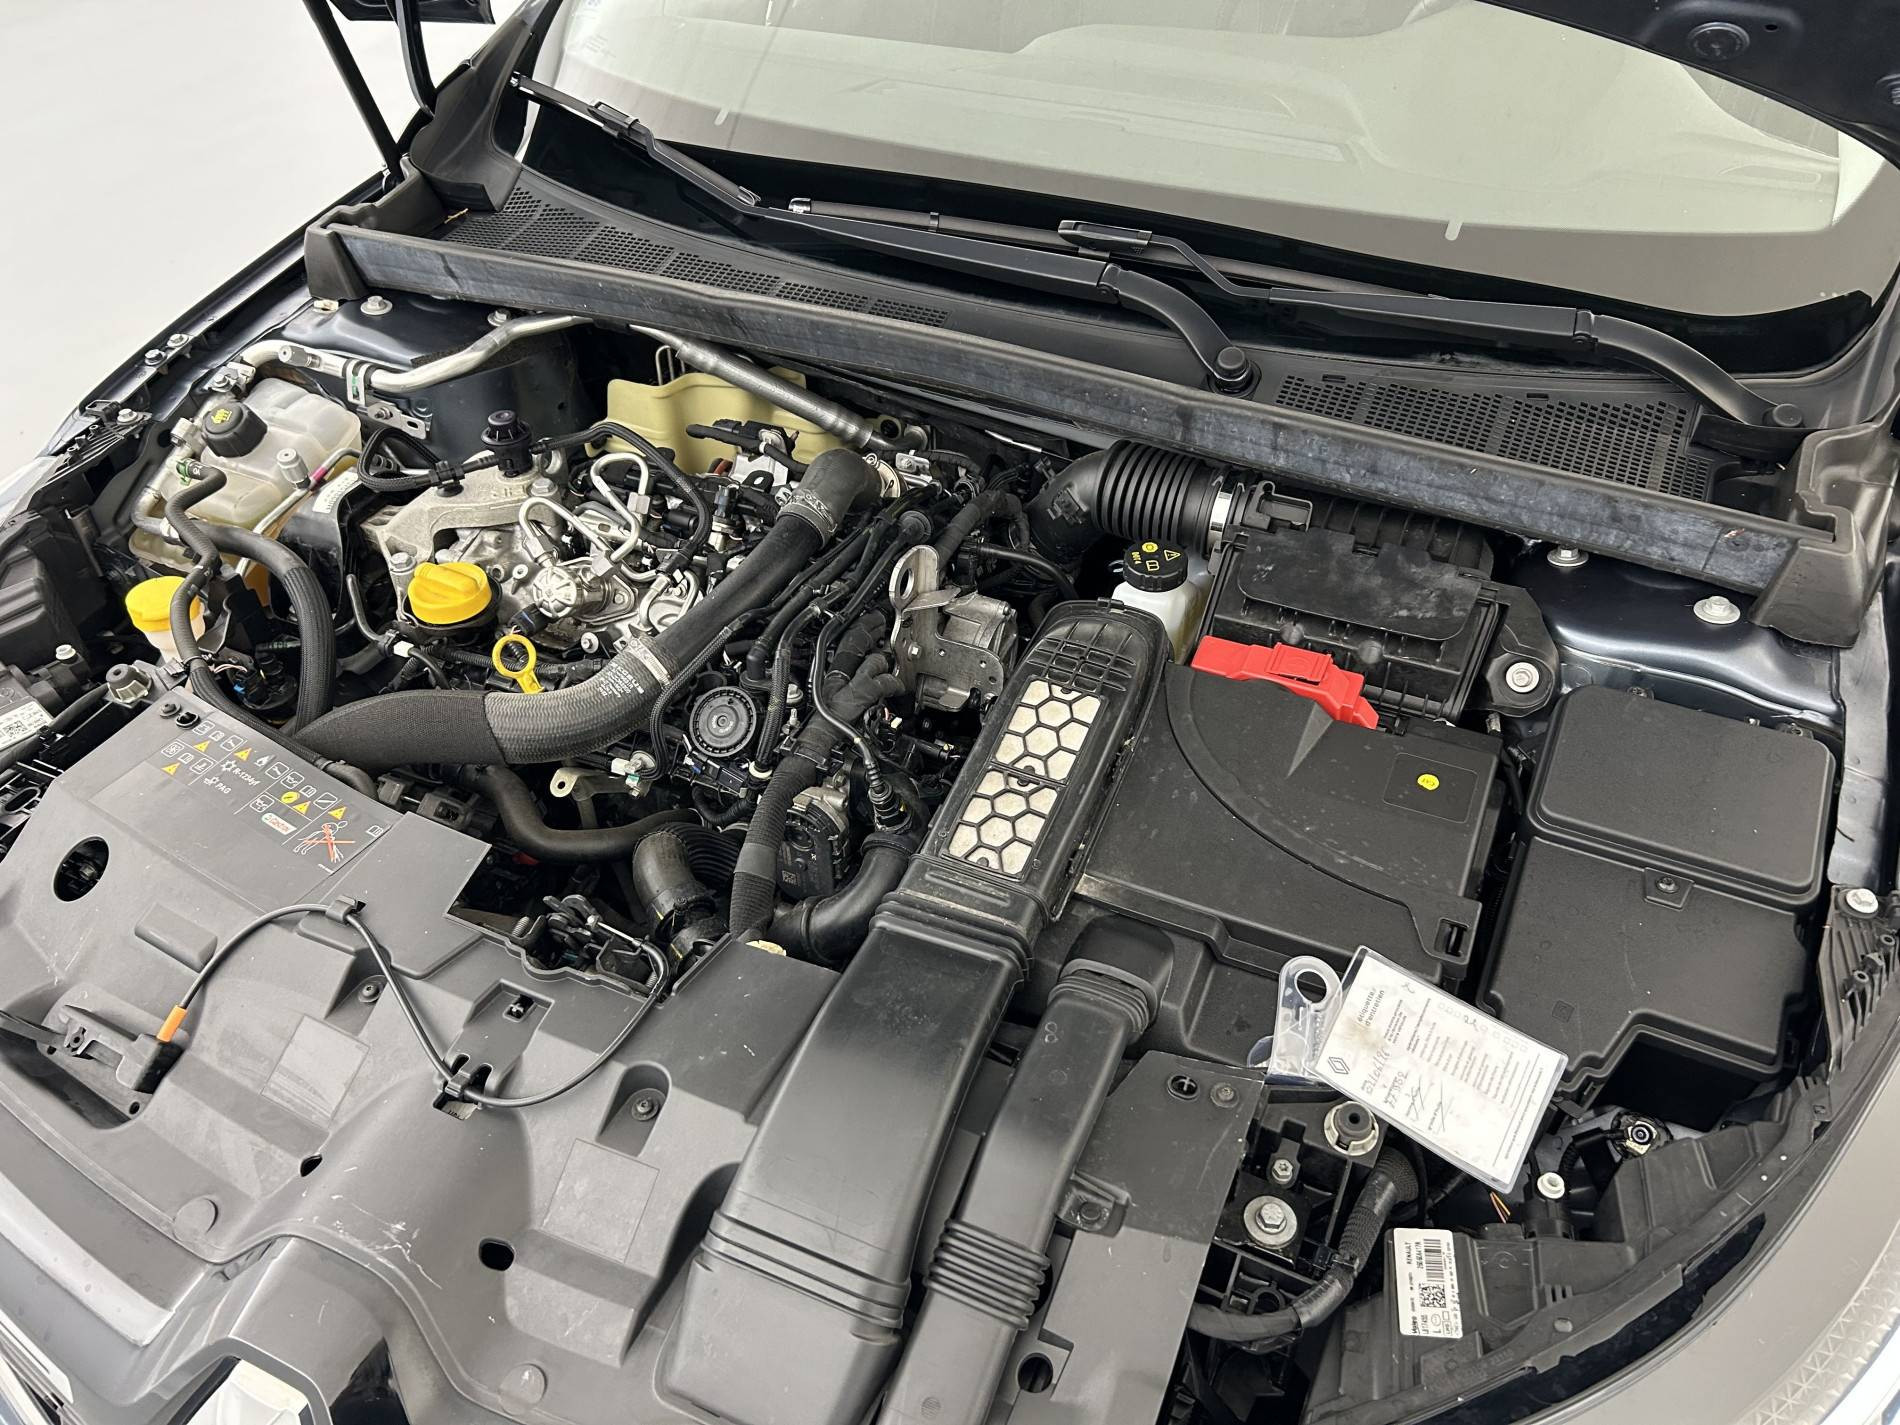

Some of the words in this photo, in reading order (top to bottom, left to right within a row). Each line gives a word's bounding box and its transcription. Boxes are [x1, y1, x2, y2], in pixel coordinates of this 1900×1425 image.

[217, 783, 232, 794] PAG
[1365, 990, 1385, 1027] d'entretien
[1405, 1242, 1413, 1265] RENAULT
[1412, 1316, 1420, 1334] Valeo
